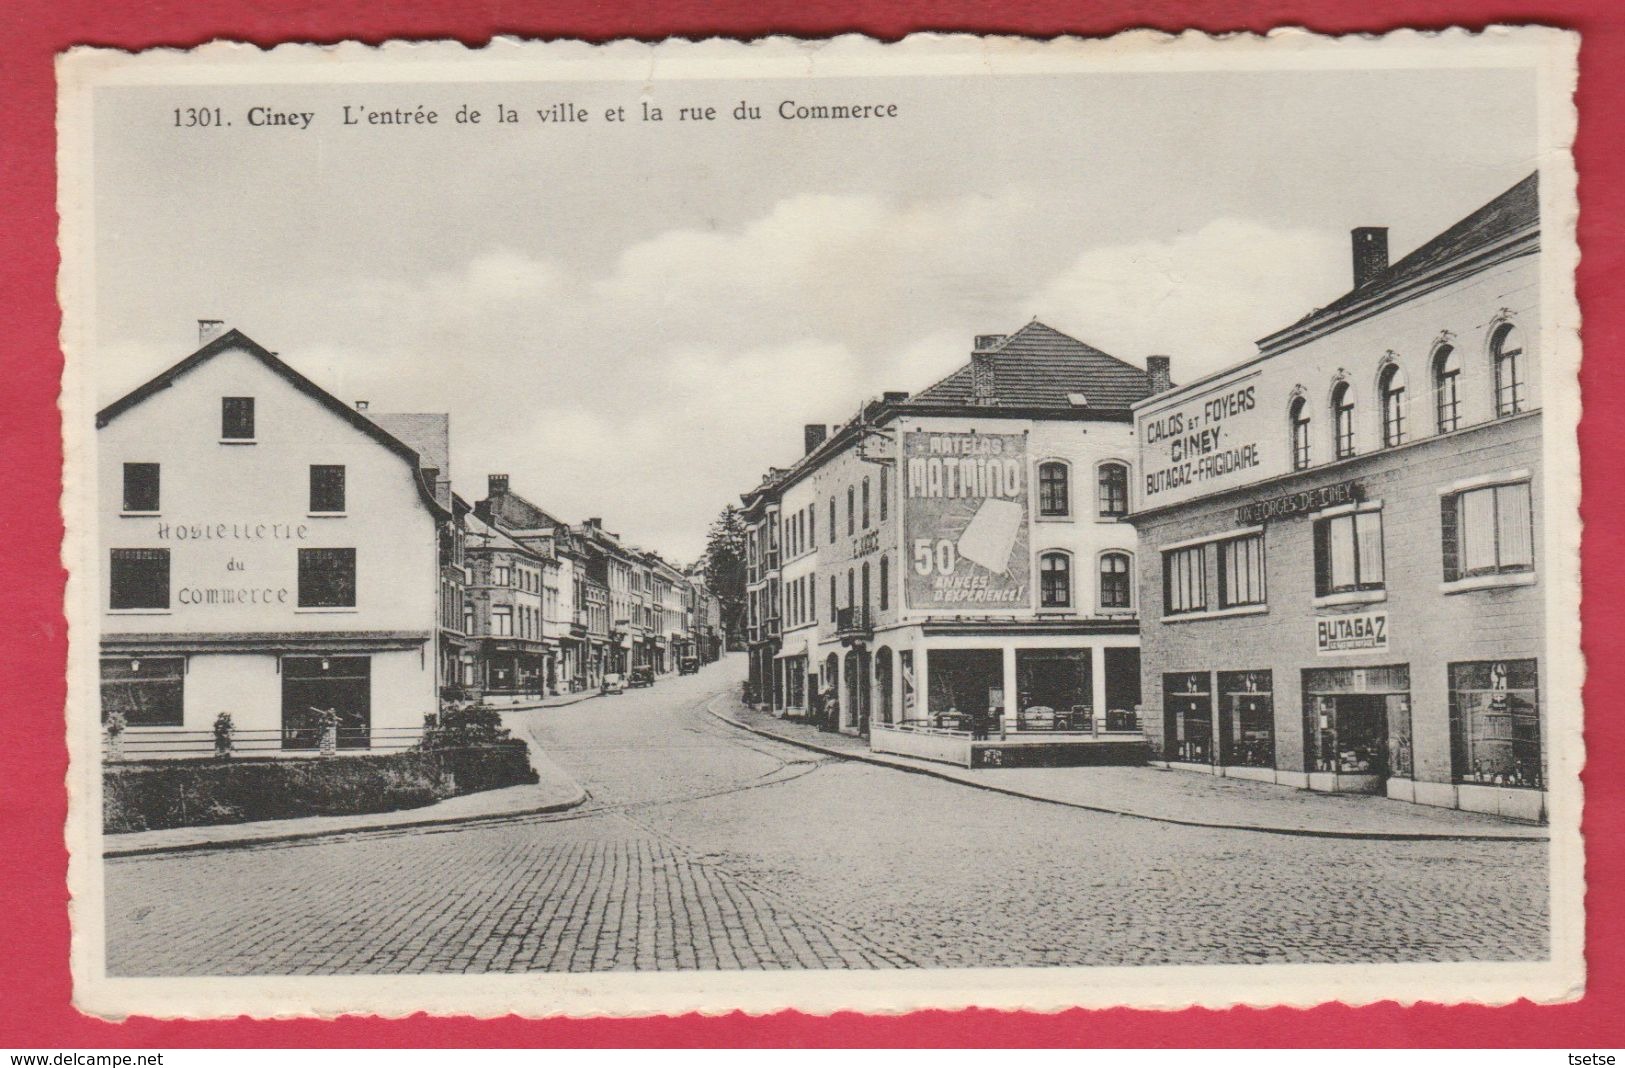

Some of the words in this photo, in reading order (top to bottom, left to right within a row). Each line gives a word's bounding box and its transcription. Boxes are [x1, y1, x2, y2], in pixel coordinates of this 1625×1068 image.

[1147, 412, 1184, 444] CALOS
[1204, 386, 1256, 425] FOYERS
[929, 436, 1003, 455] MATELAS
[1171, 426, 1221, 463] CINEY
[1146, 443, 1260, 496] BUTAGAZ-FRIGIDAIRE
[226, 556, 246, 571] du
[914, 538, 956, 576] 50
[1318, 615, 1387, 648] BUTAGAZ
